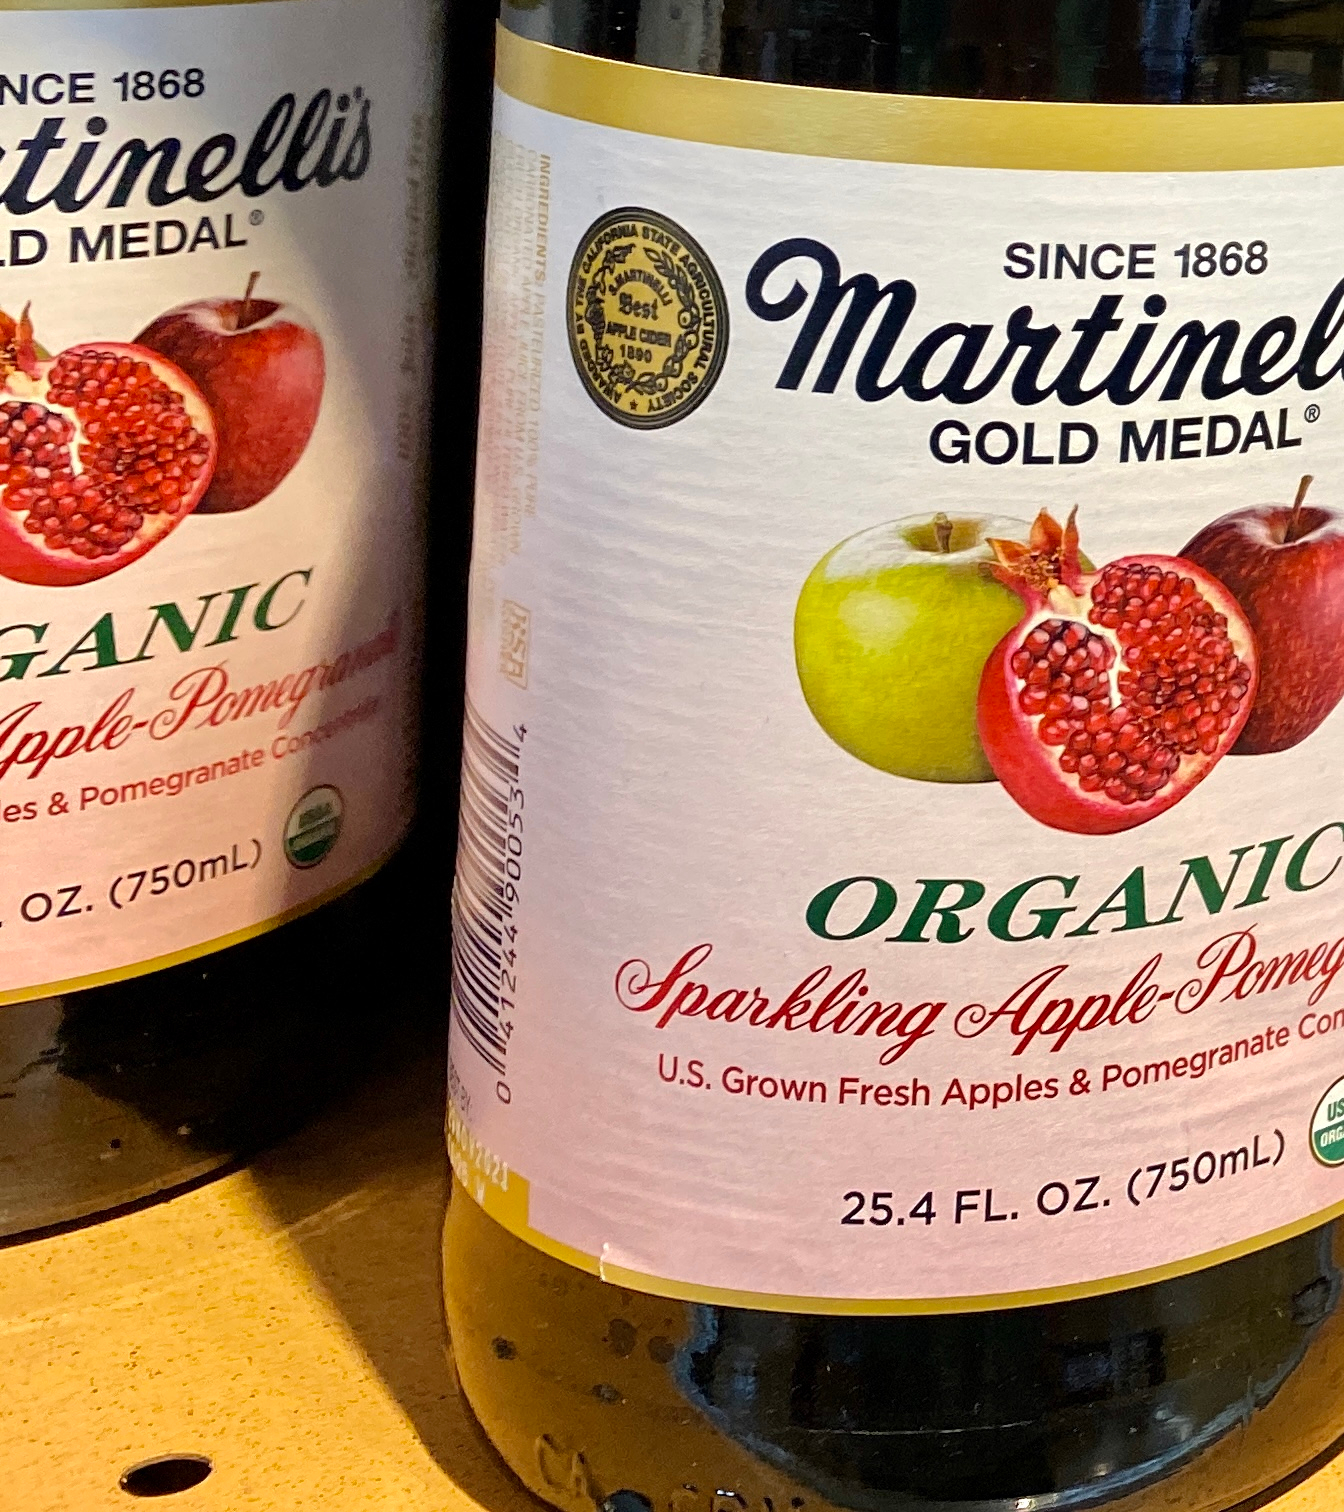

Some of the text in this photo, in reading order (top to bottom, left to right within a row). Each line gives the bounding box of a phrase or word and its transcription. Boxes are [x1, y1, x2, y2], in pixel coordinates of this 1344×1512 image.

[113, 68, 206, 102] 1868
[1003, 239, 1270, 280] SINCE 1868
[583, 223, 716, 414] CALIFORNIA STATE AGRICULTURAL SOCIETY
[619, 291, 659, 321] Best
[928, 418, 1099, 465] GOLD
[0, 568, 313, 683] GANIC
[47, 791, 70, 816] &
[79, 747, 265, 811] Pomegranate
[20, 838, 262, 923] OZ. (750mL)
[495, 722, 528, 1105] 0 41244 90053 4
[615, 943, 941, 1066] Sparkling
[658, 1053, 713, 1091] U.S.
[722, 1065, 827, 1104] Grown
[839, 1075, 932, 1108] Fresh
[942, 1068, 1059, 1111] Apples
[1068, 1065, 1091, 1096] &
[1101, 1024, 1290, 1093] Pomegranate
[840, 1127, 1286, 1228] 25.4 FL. OZ. (750mL)
